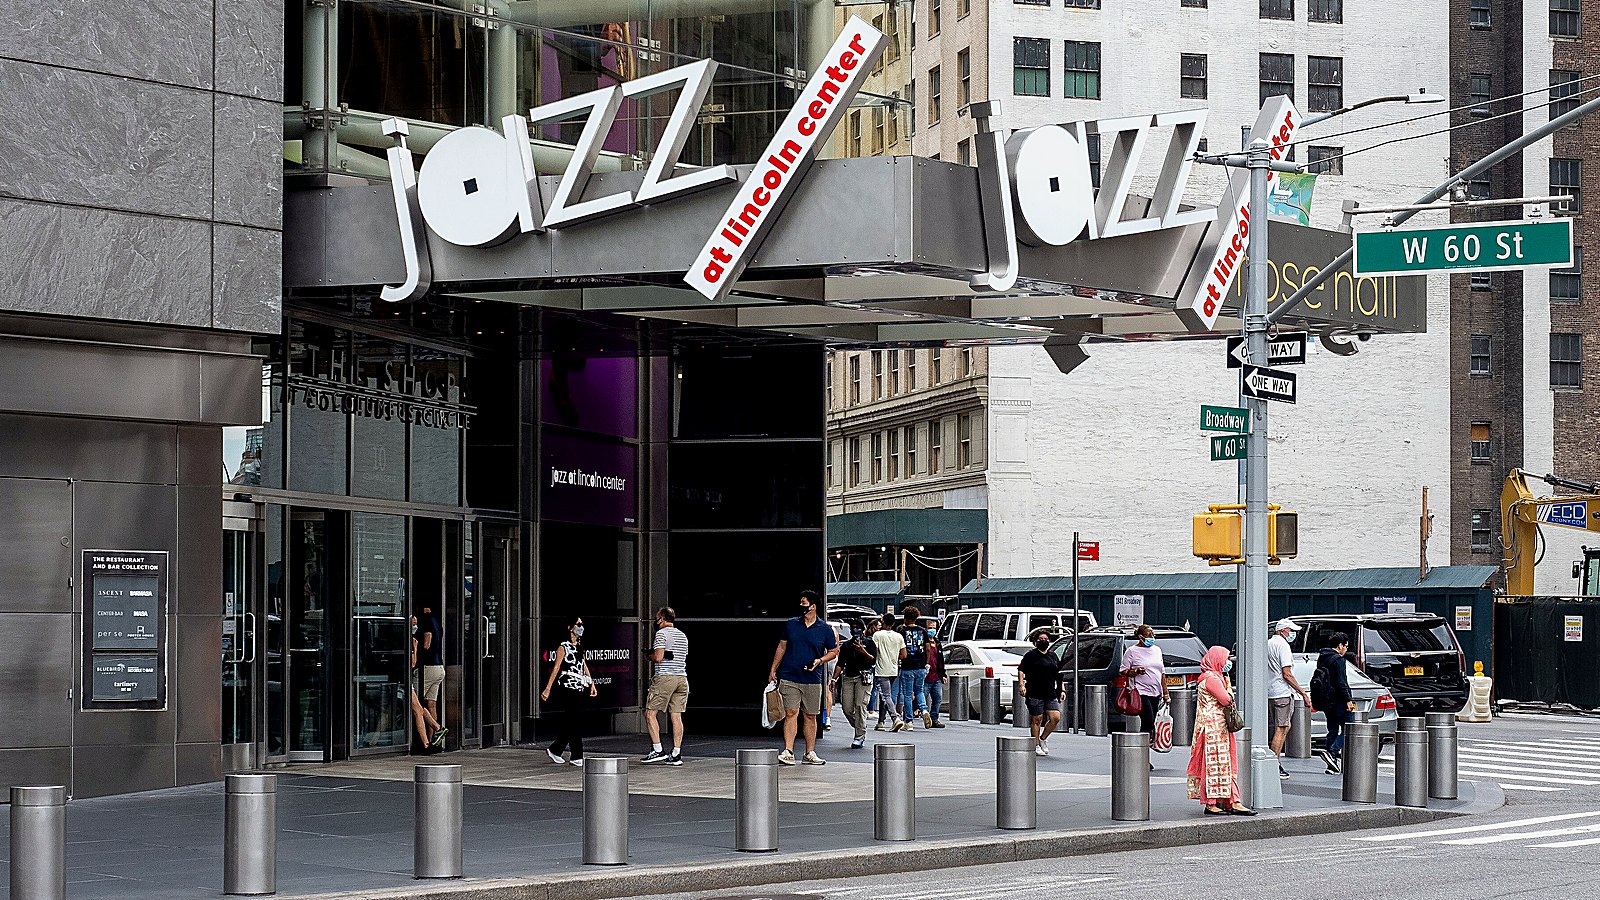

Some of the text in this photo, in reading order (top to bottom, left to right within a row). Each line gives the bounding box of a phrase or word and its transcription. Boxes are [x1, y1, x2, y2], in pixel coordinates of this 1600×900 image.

[702, 32, 869, 286] at lincoln center
[380, 57, 737, 302] jazz
[970, 98, 1218, 291] jazz
[1203, 279, 1221, 318] at
[1214, 201, 1251, 286] lincol
[1402, 231, 1525, 264] W 60 St
[1270, 342, 1295, 357] WAY
[1251, 375, 1290, 393] ONE WAY
[1205, 409, 1245, 434] Broadway
[1214, 439, 1222, 458] W
[1225, 438, 1236, 457] 60
[550, 466, 626, 491] jazz at lincoln center
[1551, 504, 1586, 519] ECD
[1124, 597, 1142, 606] Broadway
[586, 650, 594, 660] ON
[594, 650, 604, 660] THE
[614, 648, 630, 660] FLOOR
